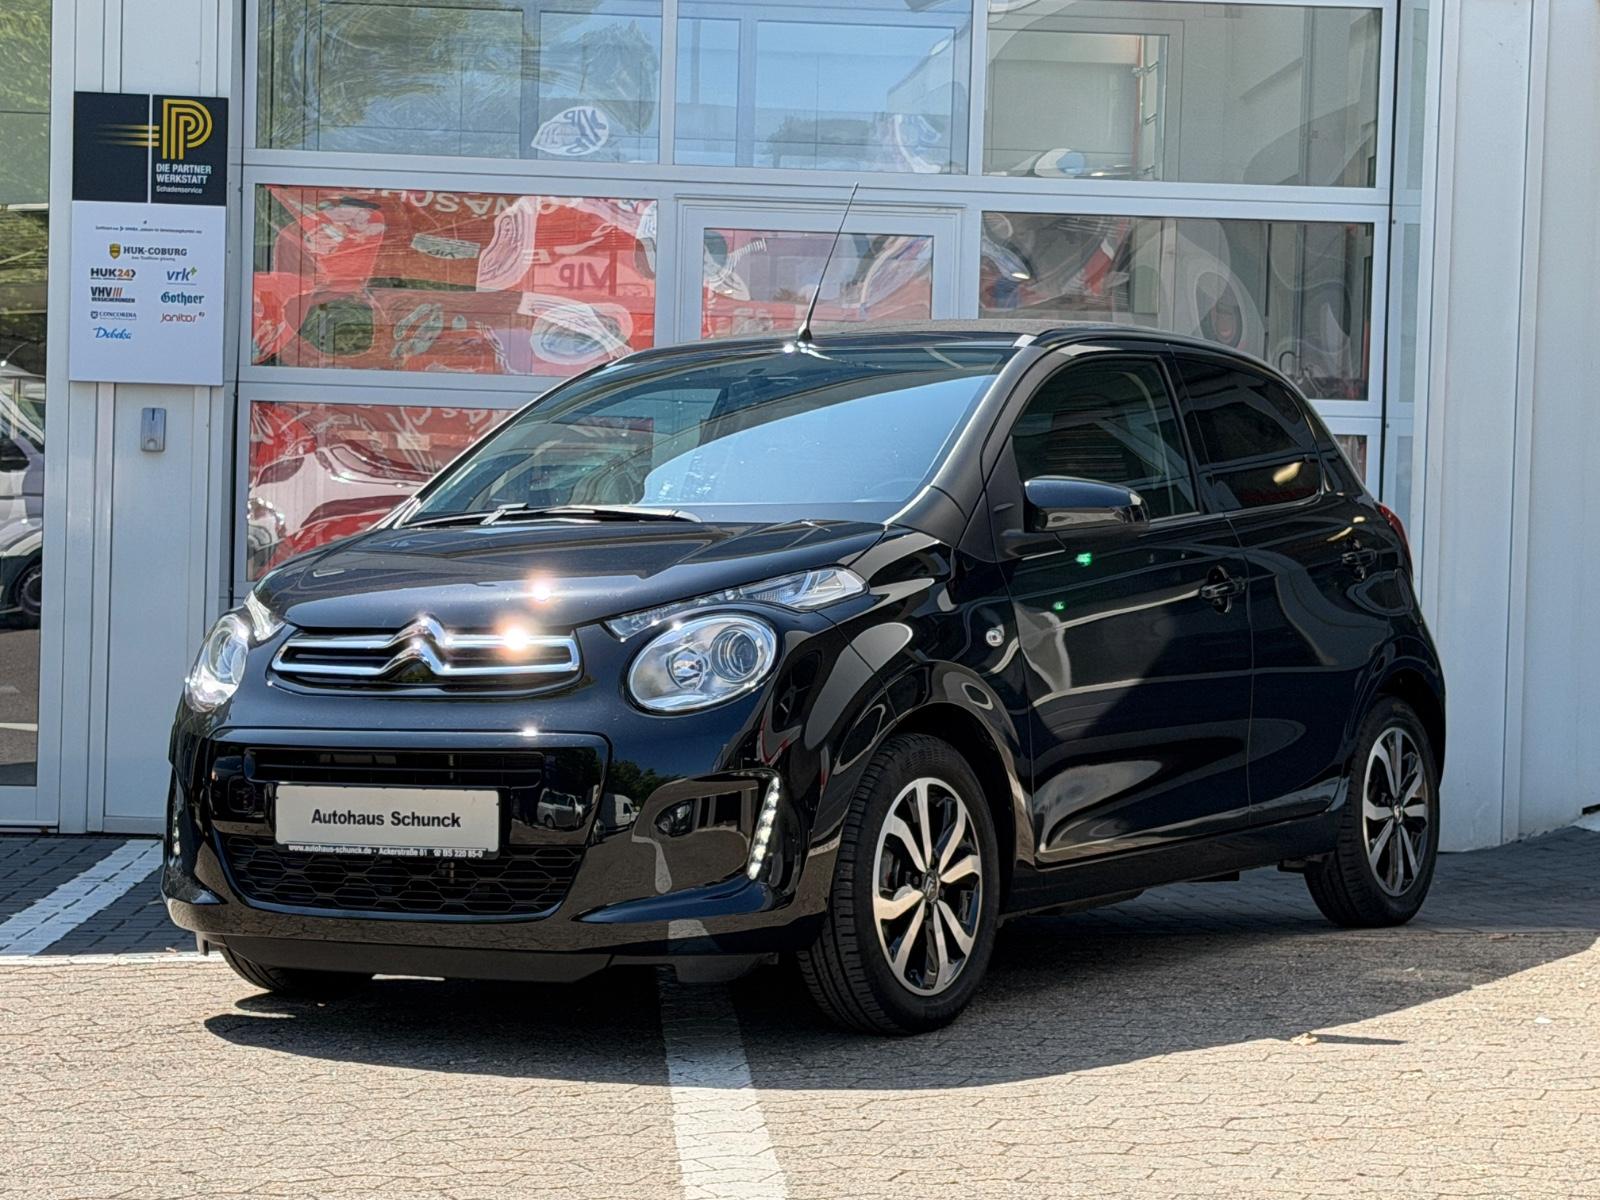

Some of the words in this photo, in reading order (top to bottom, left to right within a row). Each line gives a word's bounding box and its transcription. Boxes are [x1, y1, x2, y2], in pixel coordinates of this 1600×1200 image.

[156, 163, 170, 172] DIE
[172, 164, 212, 174] PARTNER
[156, 174, 207, 184] WERKSTATT
[156, 185, 203, 194] Schadenservice
[123, 246, 187, 256] HUK-COBURG
[166, 267, 191, 281] vrk
[90, 286, 113, 297] VHV
[160, 291, 205, 306] Gothaer
[311, 808, 385, 826] Autohaus
[390, 811, 462, 828] Schunck
[288, 844, 372, 855] www.autohaus-schunck.de
